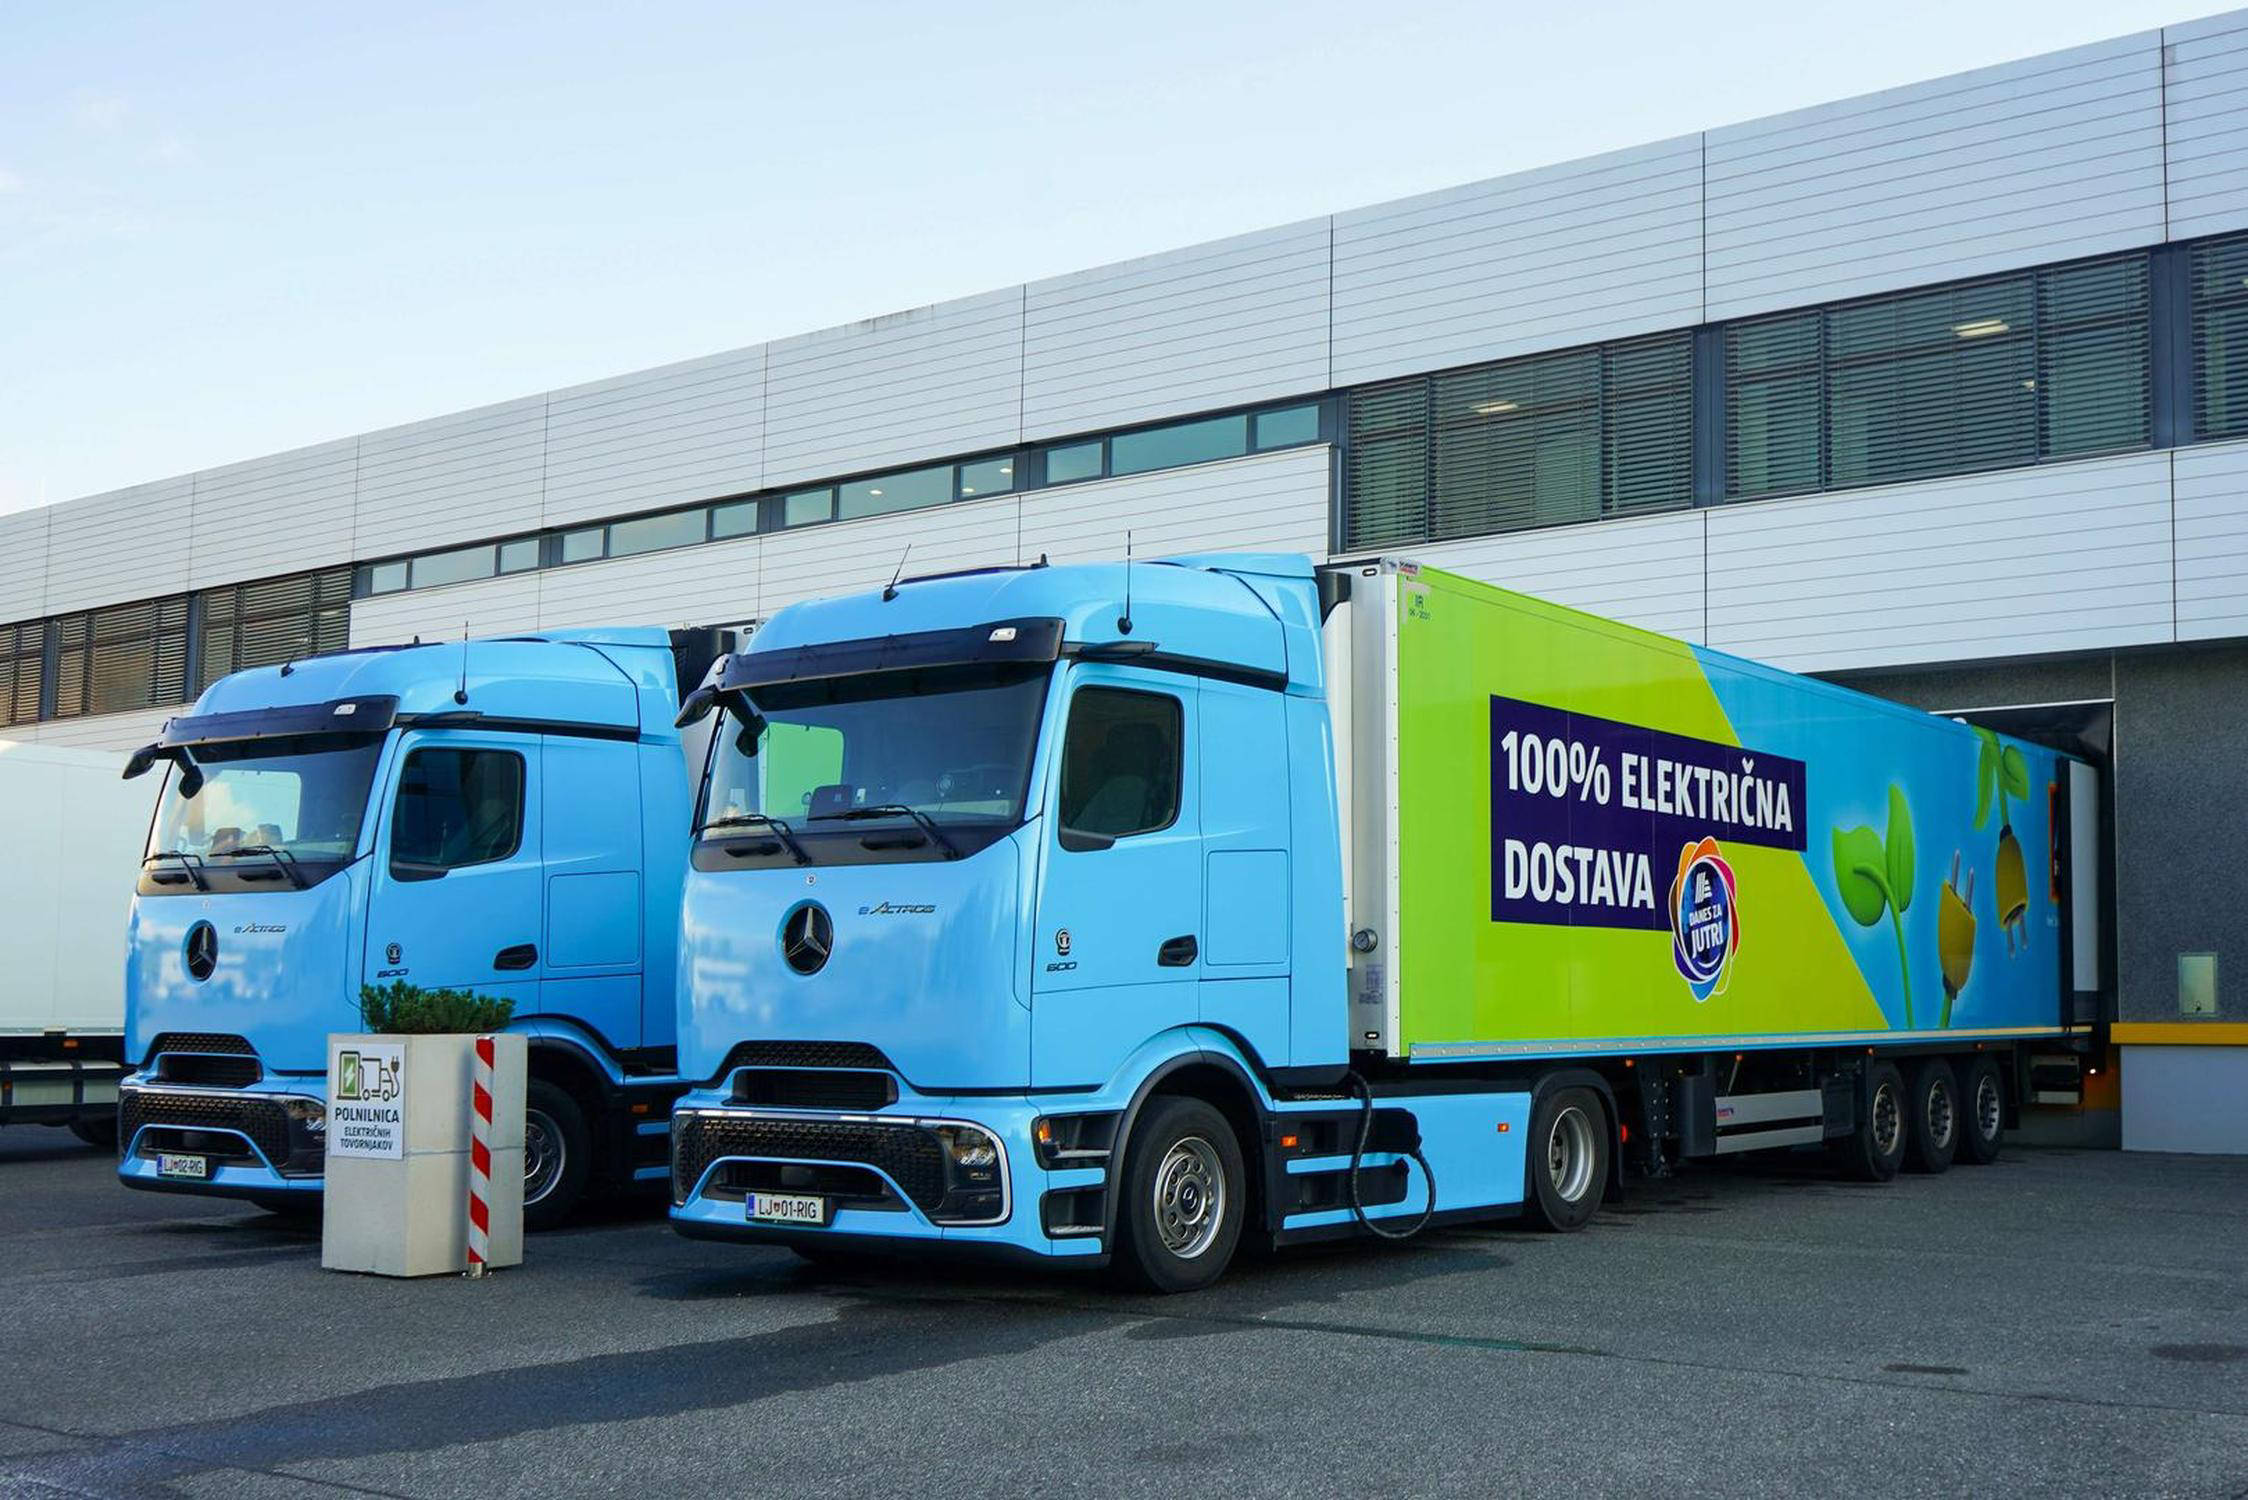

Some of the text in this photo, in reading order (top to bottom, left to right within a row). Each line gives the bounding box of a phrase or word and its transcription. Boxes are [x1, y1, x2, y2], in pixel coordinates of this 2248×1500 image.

[1501, 730, 1793, 832] 100% ELEKTRIČNA
[1504, 838, 1656, 909] DOSTAVA
[1688, 903, 1723, 926] DANES ZA
[1691, 920, 1724, 959] JUTRI
[335, 1107, 400, 1123] POLNILNICA
[344, 1125, 391, 1138] ELEKTRIČNIH
[340, 1138, 393, 1151] TOVORNJAKOV
[759, 1199, 817, 1219] LJ 01-RIG
